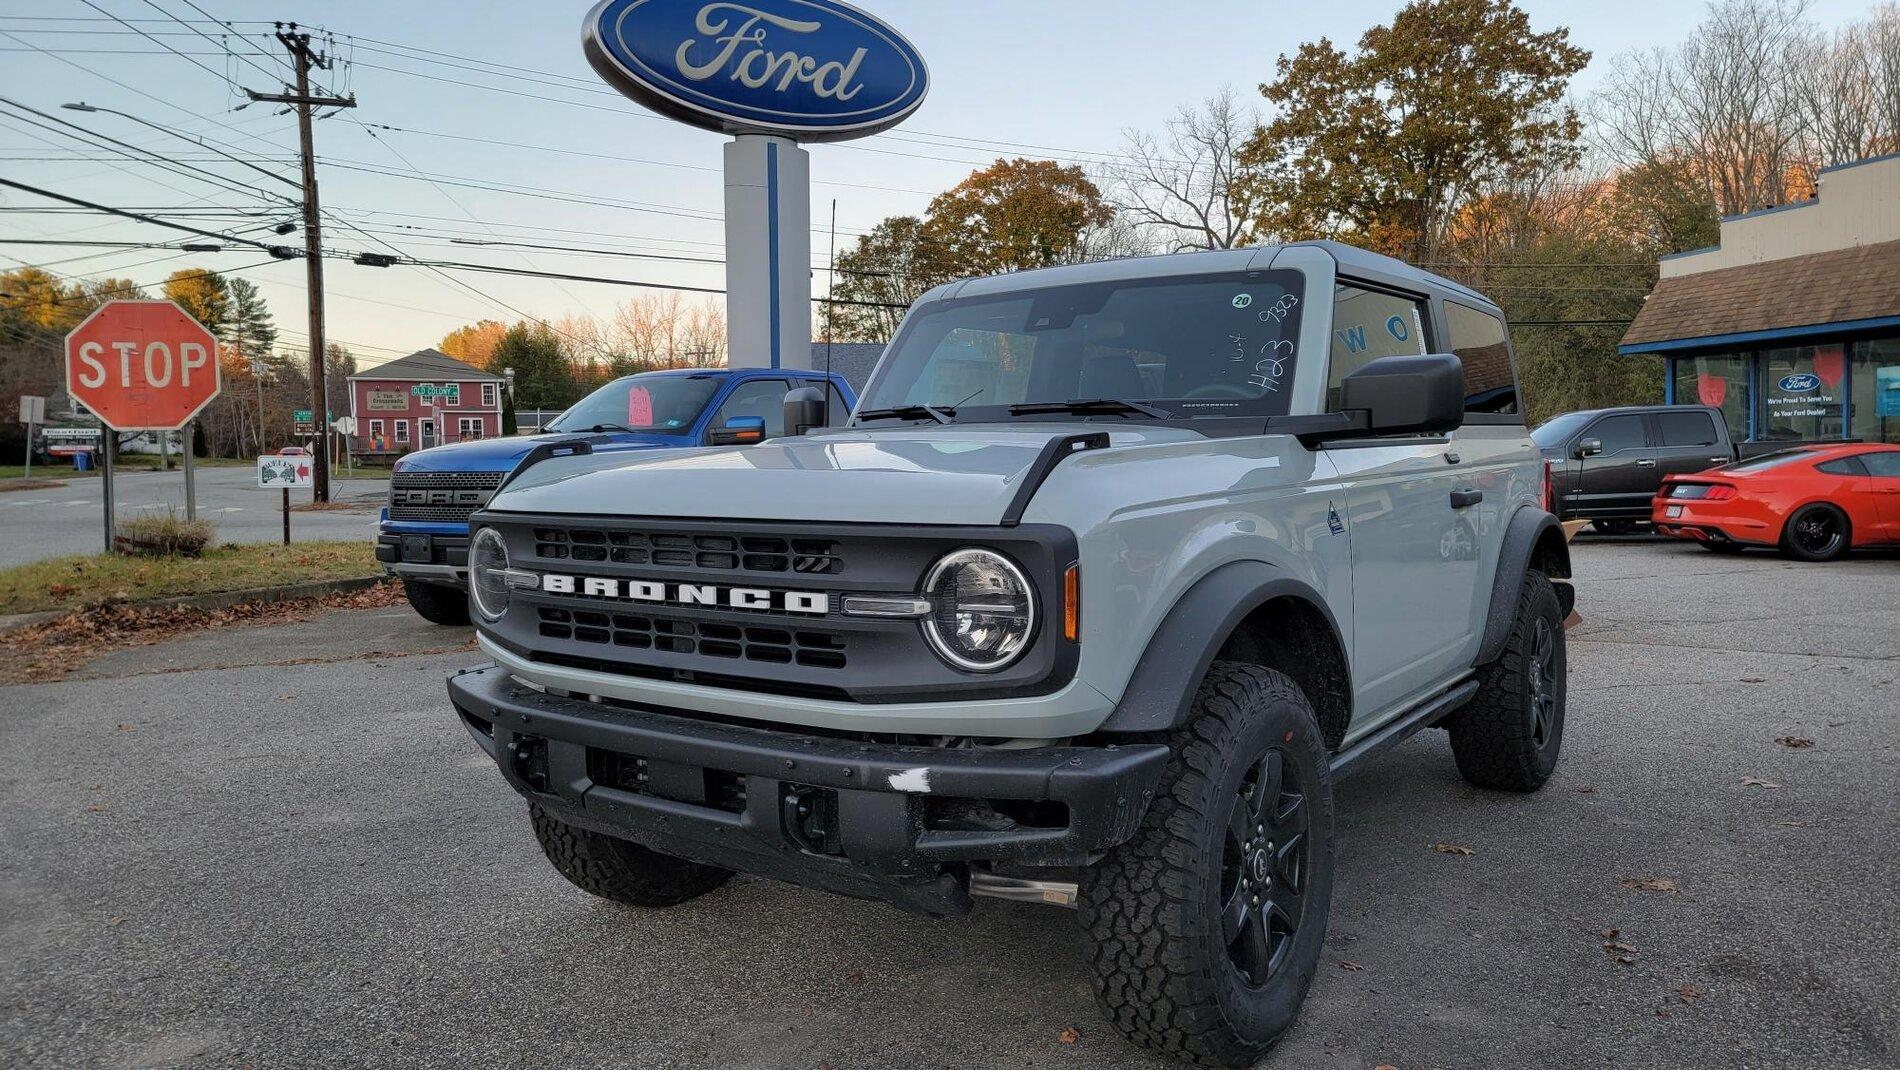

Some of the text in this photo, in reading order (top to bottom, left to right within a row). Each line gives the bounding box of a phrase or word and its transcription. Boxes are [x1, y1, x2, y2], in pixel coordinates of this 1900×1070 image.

[675, 2, 869, 101] Ford
[1234, 296, 1250, 306] 20
[78, 341, 208, 389] STOP
[1785, 376, 1812, 389] Ford
[412, 386, 426, 395] OLD
[427, 387, 452, 396] COLONY
[1807, 408, 1826, 416] Dealer!
[542, 574, 830, 614] BRONCO
